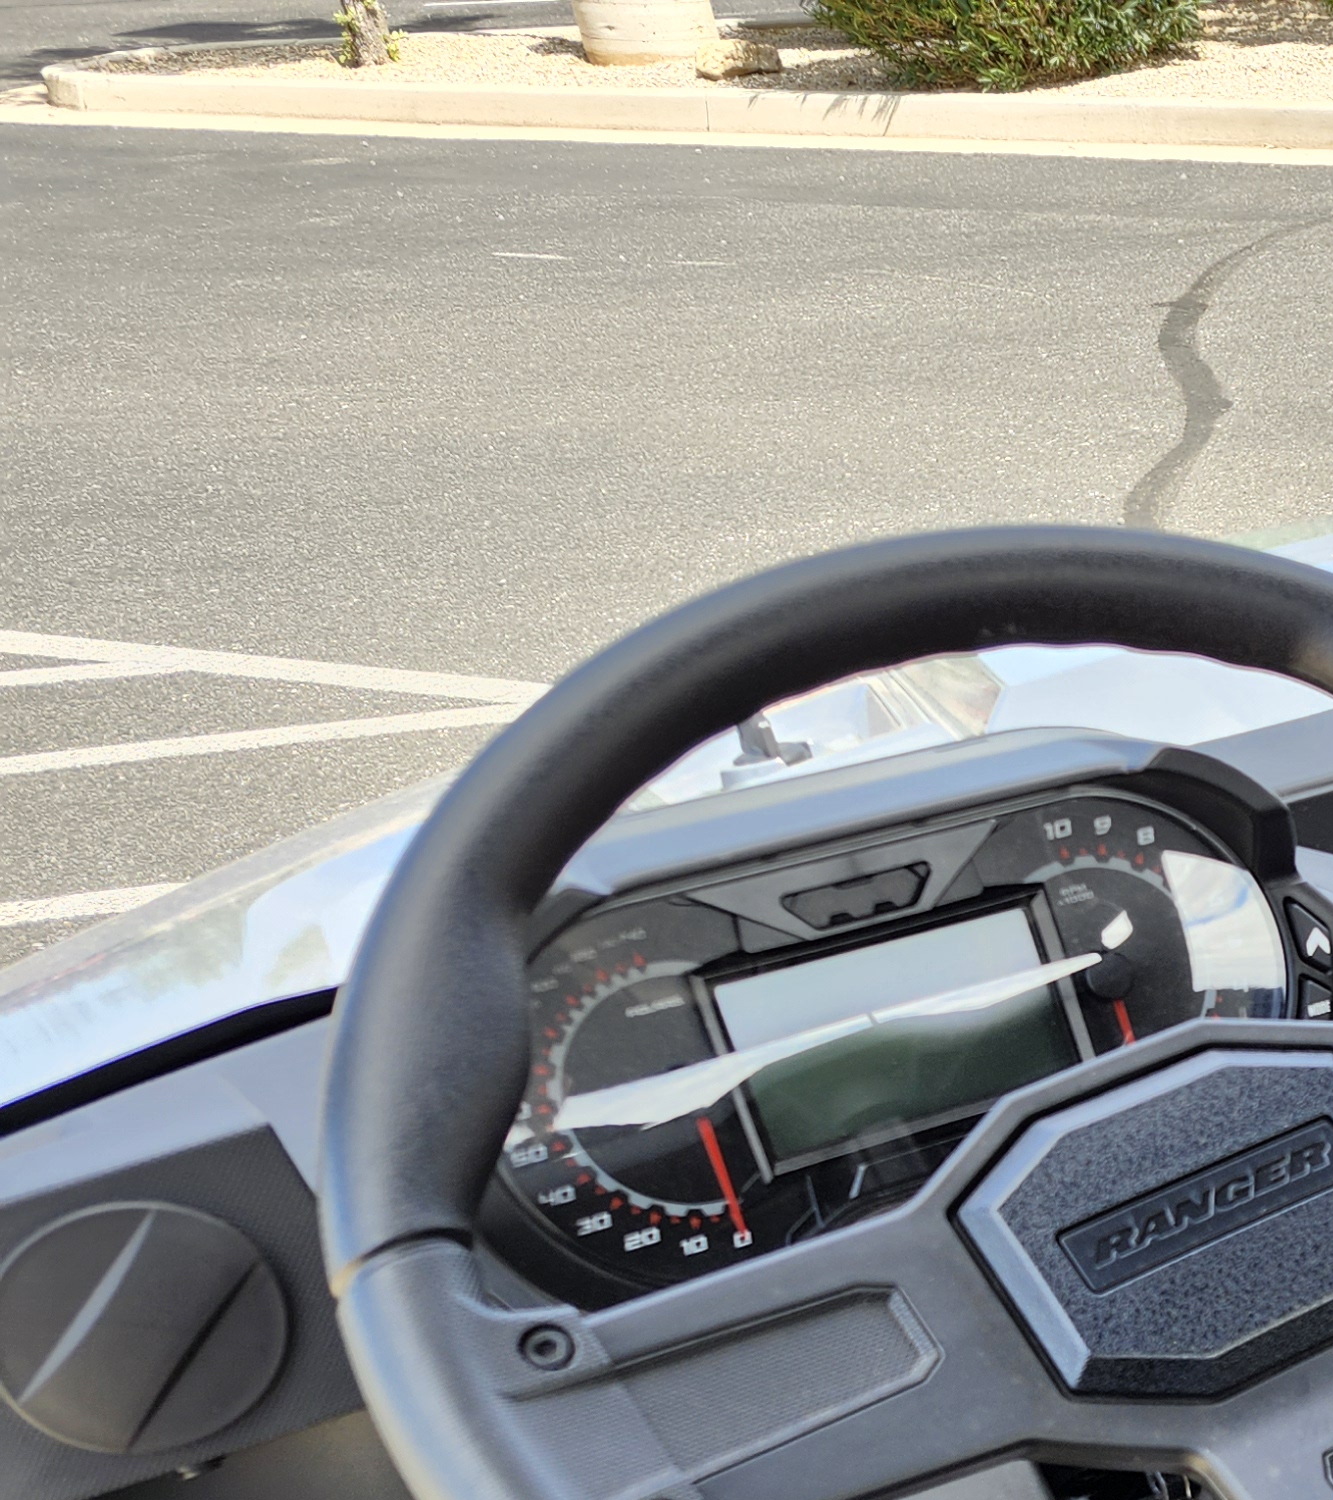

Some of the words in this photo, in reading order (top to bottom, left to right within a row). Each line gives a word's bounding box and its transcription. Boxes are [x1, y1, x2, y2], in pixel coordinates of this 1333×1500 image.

[1043, 818, 1072, 841] 10
[1093, 815, 1112, 836] 9
[1136, 825, 1155, 846] 8
[510, 1143, 548, 1168] 50
[537, 1184, 577, 1206] 40
[1094, 1141, 1331, 1270] RANGER
[574, 1211, 613, 1237] 30
[623, 1226, 661, 1252] 20
[679, 1234, 709, 1256] 10
[733, 1230, 753, 1249] 0
